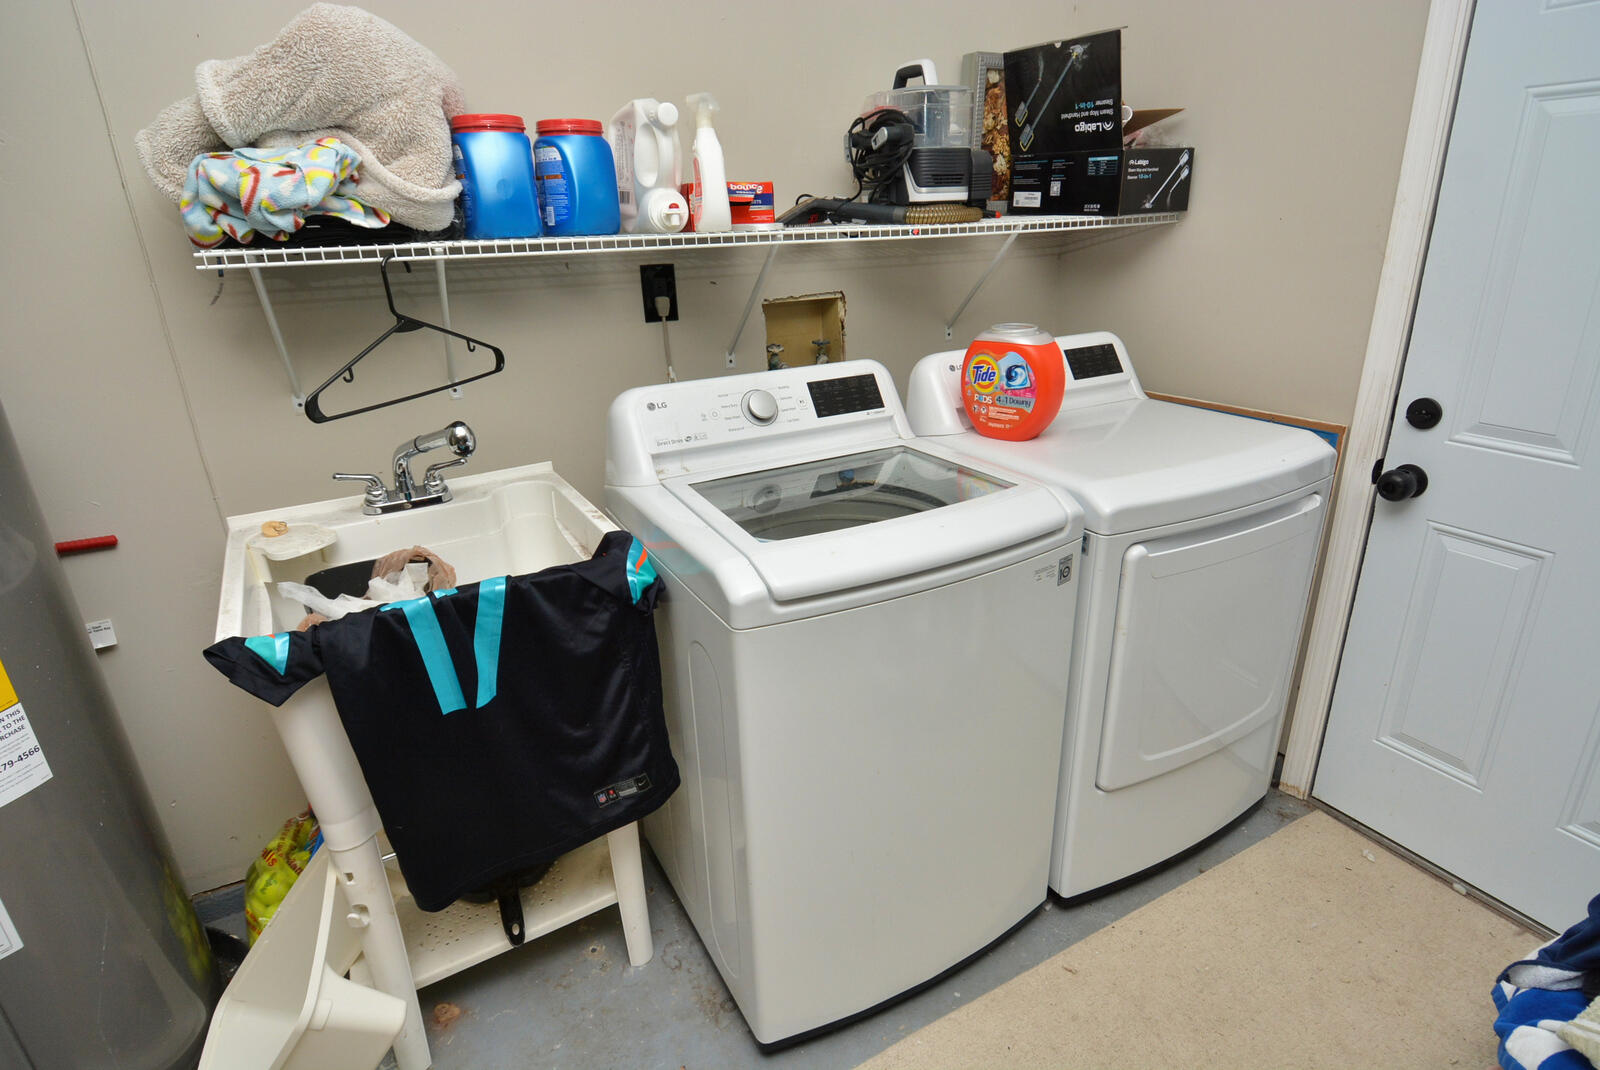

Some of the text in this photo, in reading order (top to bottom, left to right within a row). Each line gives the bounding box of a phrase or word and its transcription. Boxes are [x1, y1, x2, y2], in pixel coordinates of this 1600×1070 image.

[1075, 122, 1102, 133] Labigo
[972, 365, 997, 385] Tide
[656, 401, 668, 409] LG
[1009, 398, 1031, 408] Downy
[6, 709, 21, 719] THIS
[2, 714, 26, 730] TO THE
[0, 744, 40, 773] 79-4566
